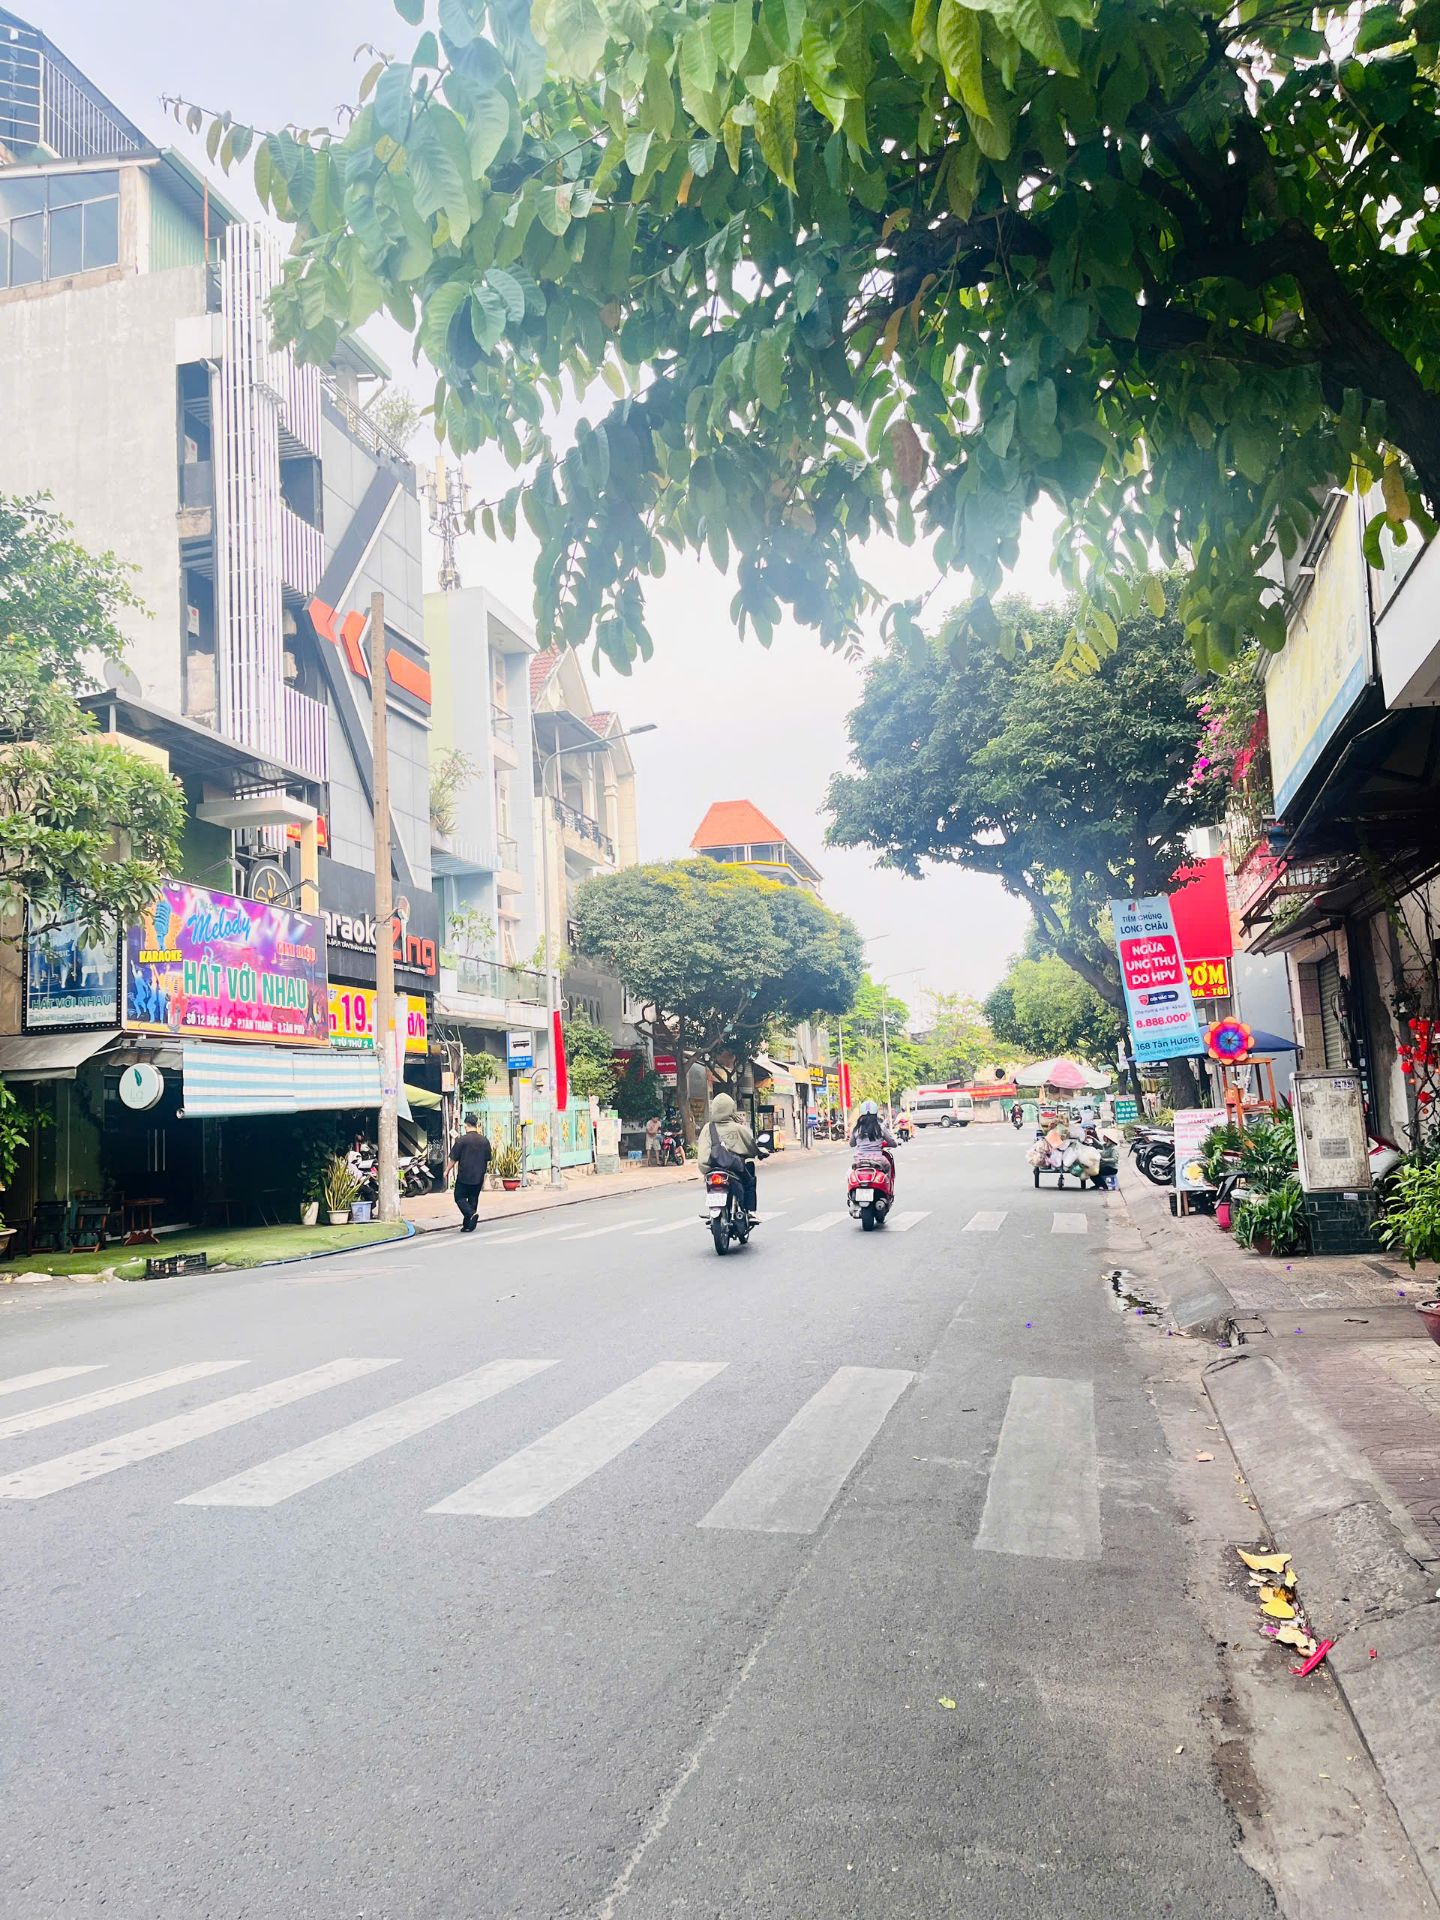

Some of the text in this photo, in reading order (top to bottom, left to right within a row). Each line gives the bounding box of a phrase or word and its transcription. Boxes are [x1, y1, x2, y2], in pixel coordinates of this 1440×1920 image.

[187, 908, 251, 945] Melody
[320, 909, 377, 946] araok
[1120, 920, 1169, 934] LONG CHÂU
[1131, 941, 1166, 956] NGỪA
[139, 950, 183, 963] KARAOKE
[1125, 954, 1176, 972] UNG THƯ
[183, 955, 308, 1010] HÁT VỚI NHAU
[1131, 969, 1176, 985] DO HPV
[1191, 988, 1205, 997] ƯA
[31, 995, 112, 1010] HÁT VỚI NHAU
[197, 1014, 205, 1026] 12
[341, 993, 373, 1033] 19.
[363, 1041, 368, 1049] 2
[1136, 1042, 1151, 1051] 168
[1152, 1040, 1169, 1049] Tân
